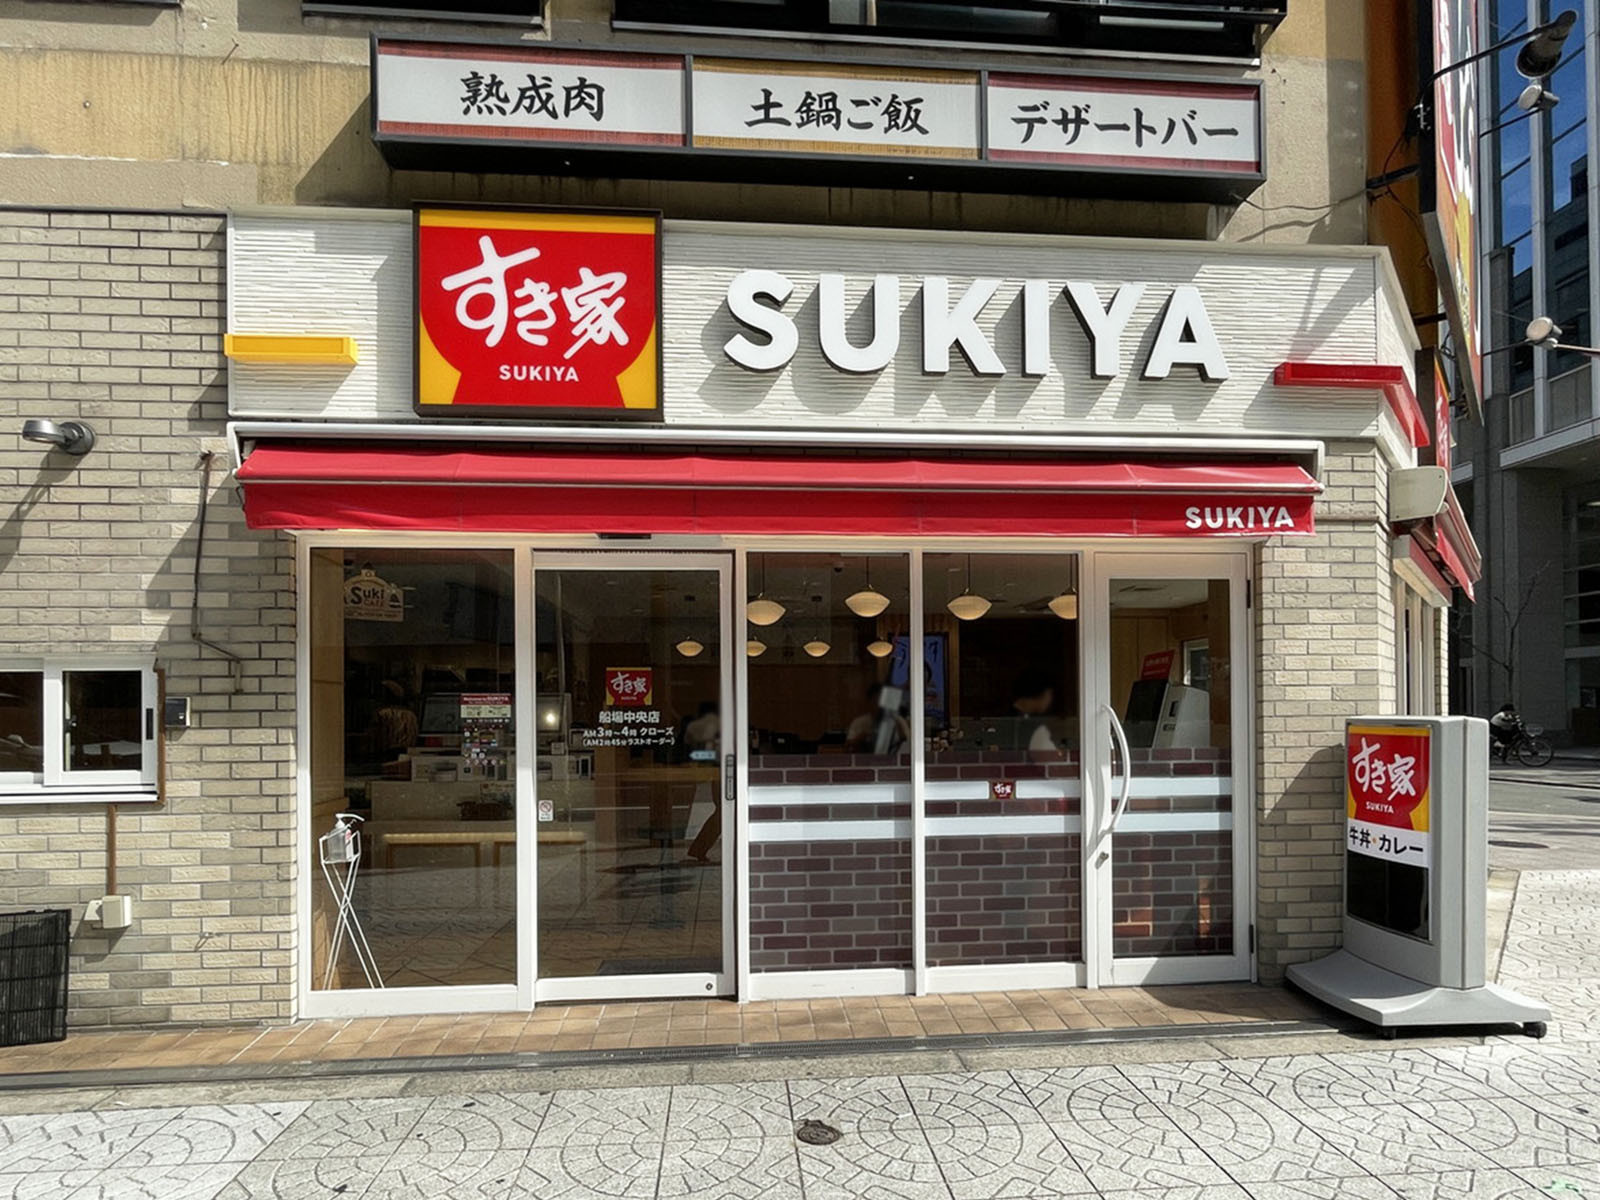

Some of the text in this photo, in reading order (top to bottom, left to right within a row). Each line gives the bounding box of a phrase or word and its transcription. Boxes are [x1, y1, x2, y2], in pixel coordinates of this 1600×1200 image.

[460, 70, 606, 122] 熟成肉
[744, 88, 930, 136] 土鍋ご飯
[1010, 100, 1240, 148] デザートバー
[441, 235, 629, 359] すき家
[723, 269, 1230, 381] SUKIYA
[499, 364, 579, 382] SUKIYA
[1185, 506, 1295, 529] SUKIYA
[350, 586, 385, 605] Suki
[610, 671, 647, 696] すき家
[639, 726, 674, 736] クローズ
[1351, 737, 1416, 801] すき家
[1365, 801, 1395, 814] SUKIYA
